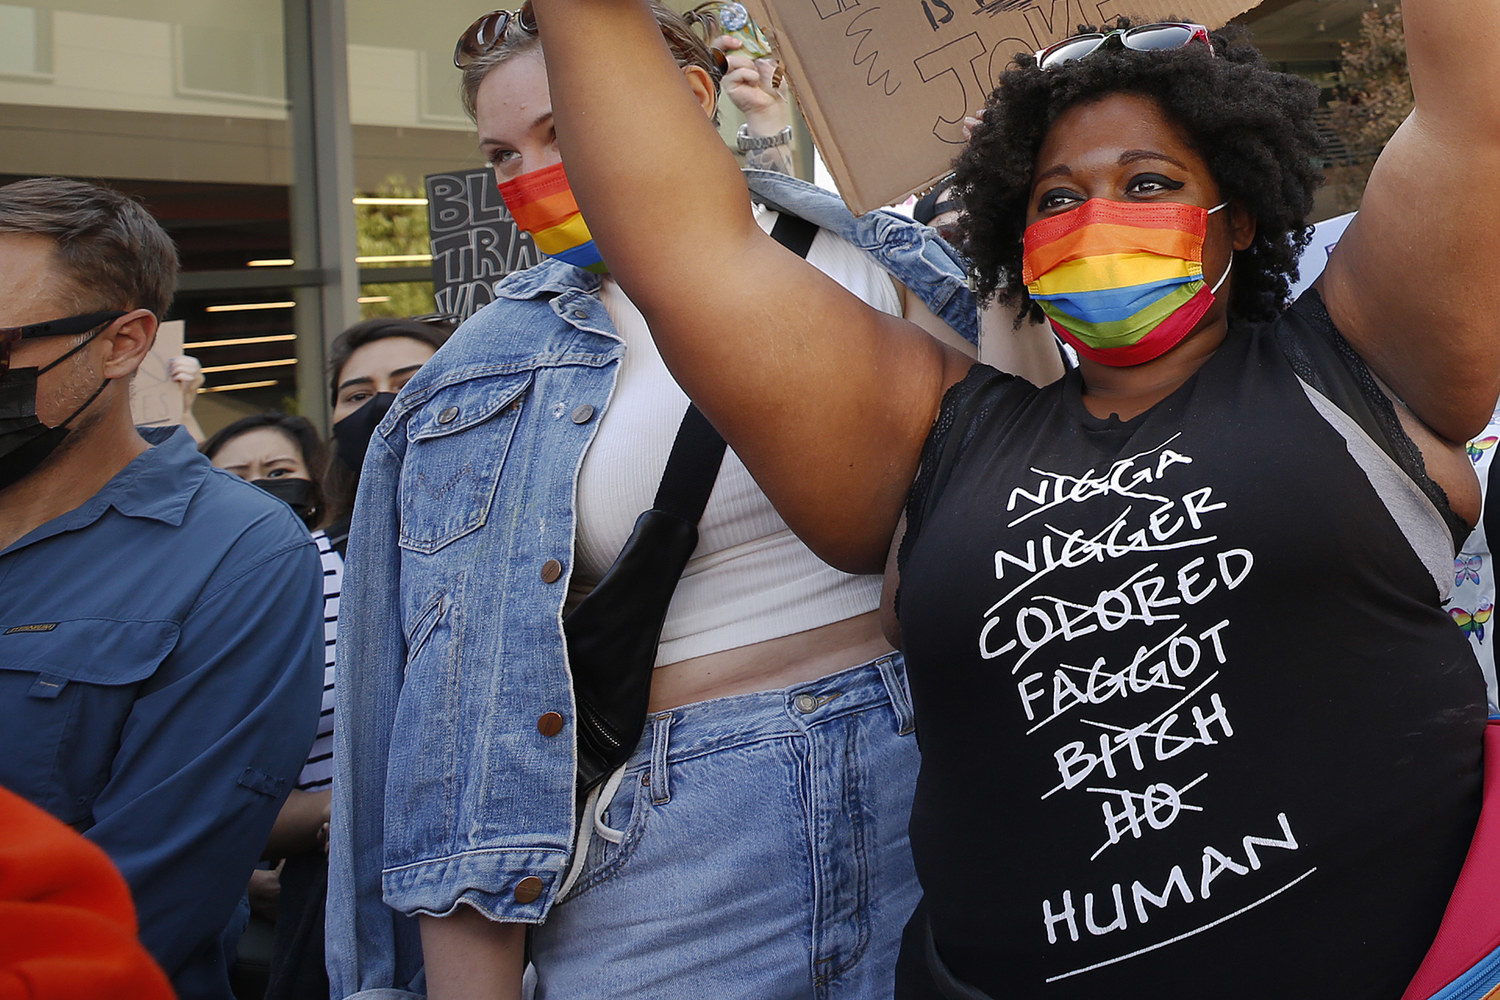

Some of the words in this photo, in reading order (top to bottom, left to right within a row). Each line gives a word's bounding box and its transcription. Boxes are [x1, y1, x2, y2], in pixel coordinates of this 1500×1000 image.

[425, 173, 516, 232] BL
[430, 223, 547, 283] TRA
[1007, 447, 1193, 512] NIGGA
[994, 486, 1227, 580] NIGGER
[979, 548, 1254, 660] COLORED
[1018, 619, 1230, 721] FAGGOT
[1054, 693, 1233, 790] BITCH
[1103, 782, 1182, 844] HO
[1043, 811, 1299, 945] HUMAN
